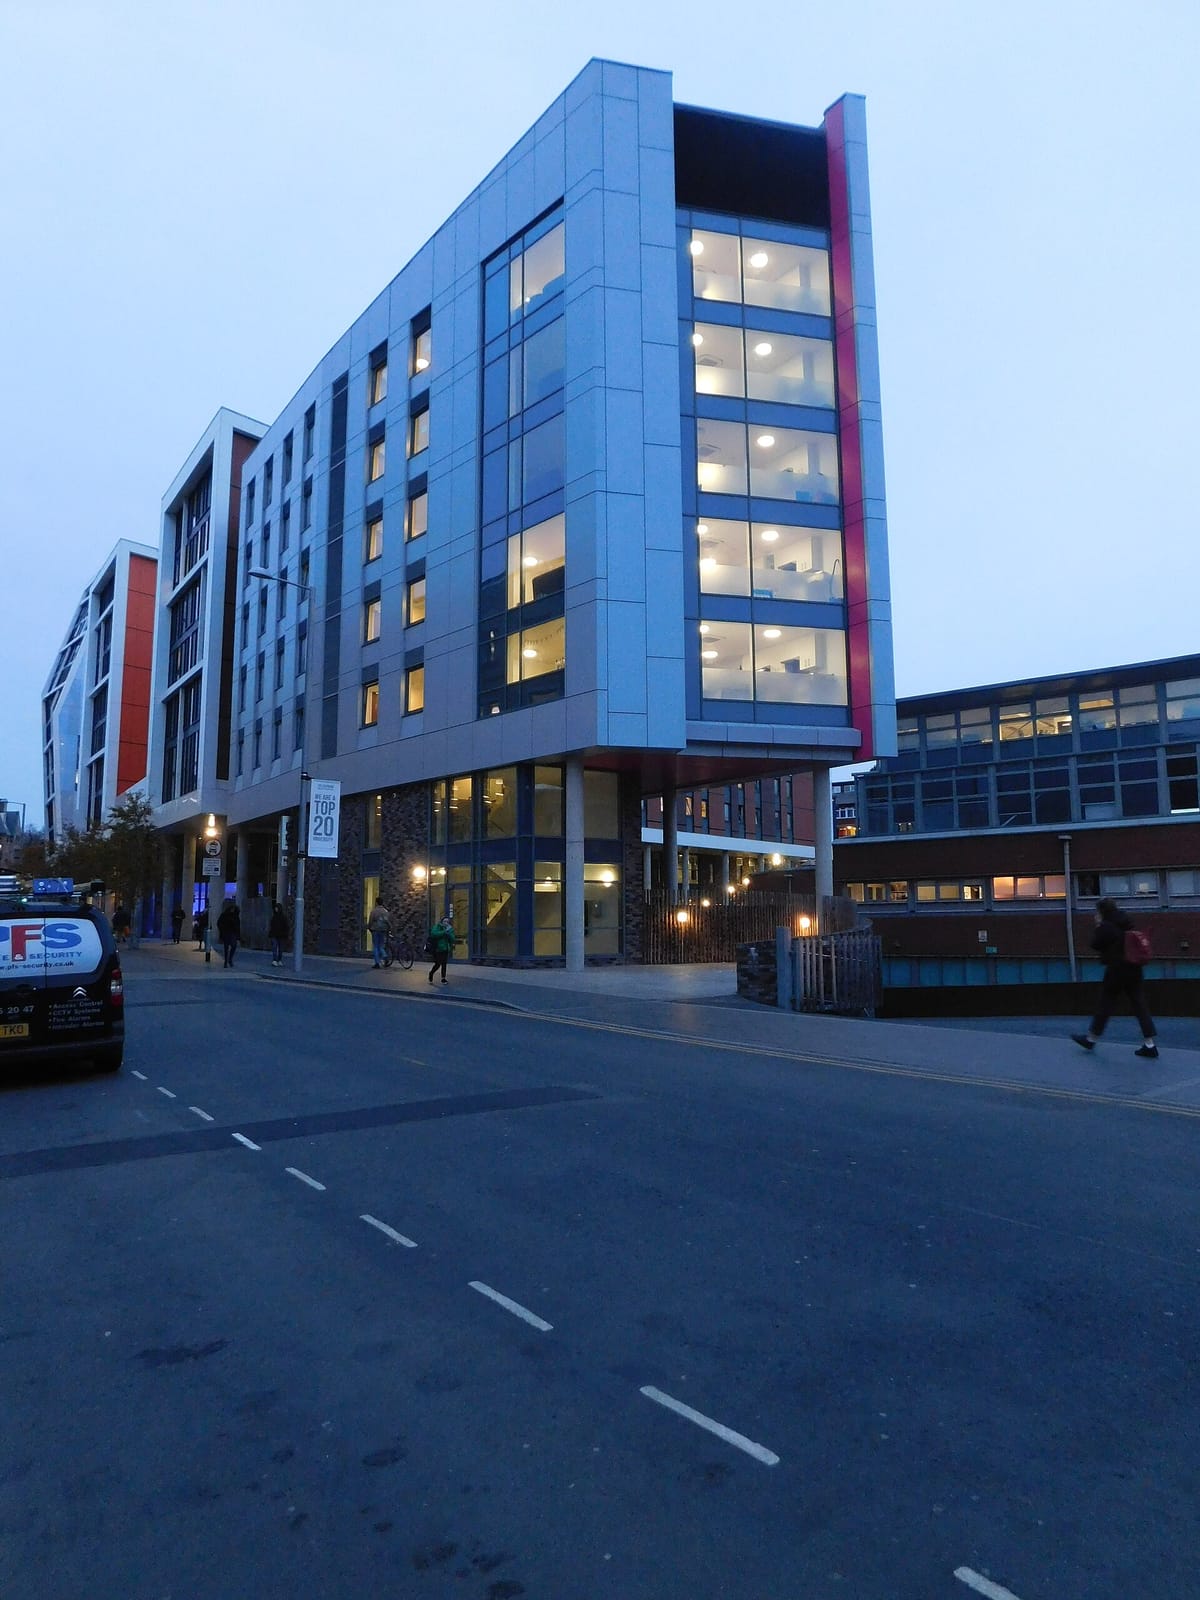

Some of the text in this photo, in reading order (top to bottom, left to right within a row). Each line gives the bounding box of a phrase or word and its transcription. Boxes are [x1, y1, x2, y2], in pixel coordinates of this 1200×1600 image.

[314, 800, 336, 815] TOP
[313, 816, 334, 836] 20
[29, 951, 82, 960] SECURITY
[7, 1006, 20, 1014] 20
[22, 1005, 35, 1013] 47
